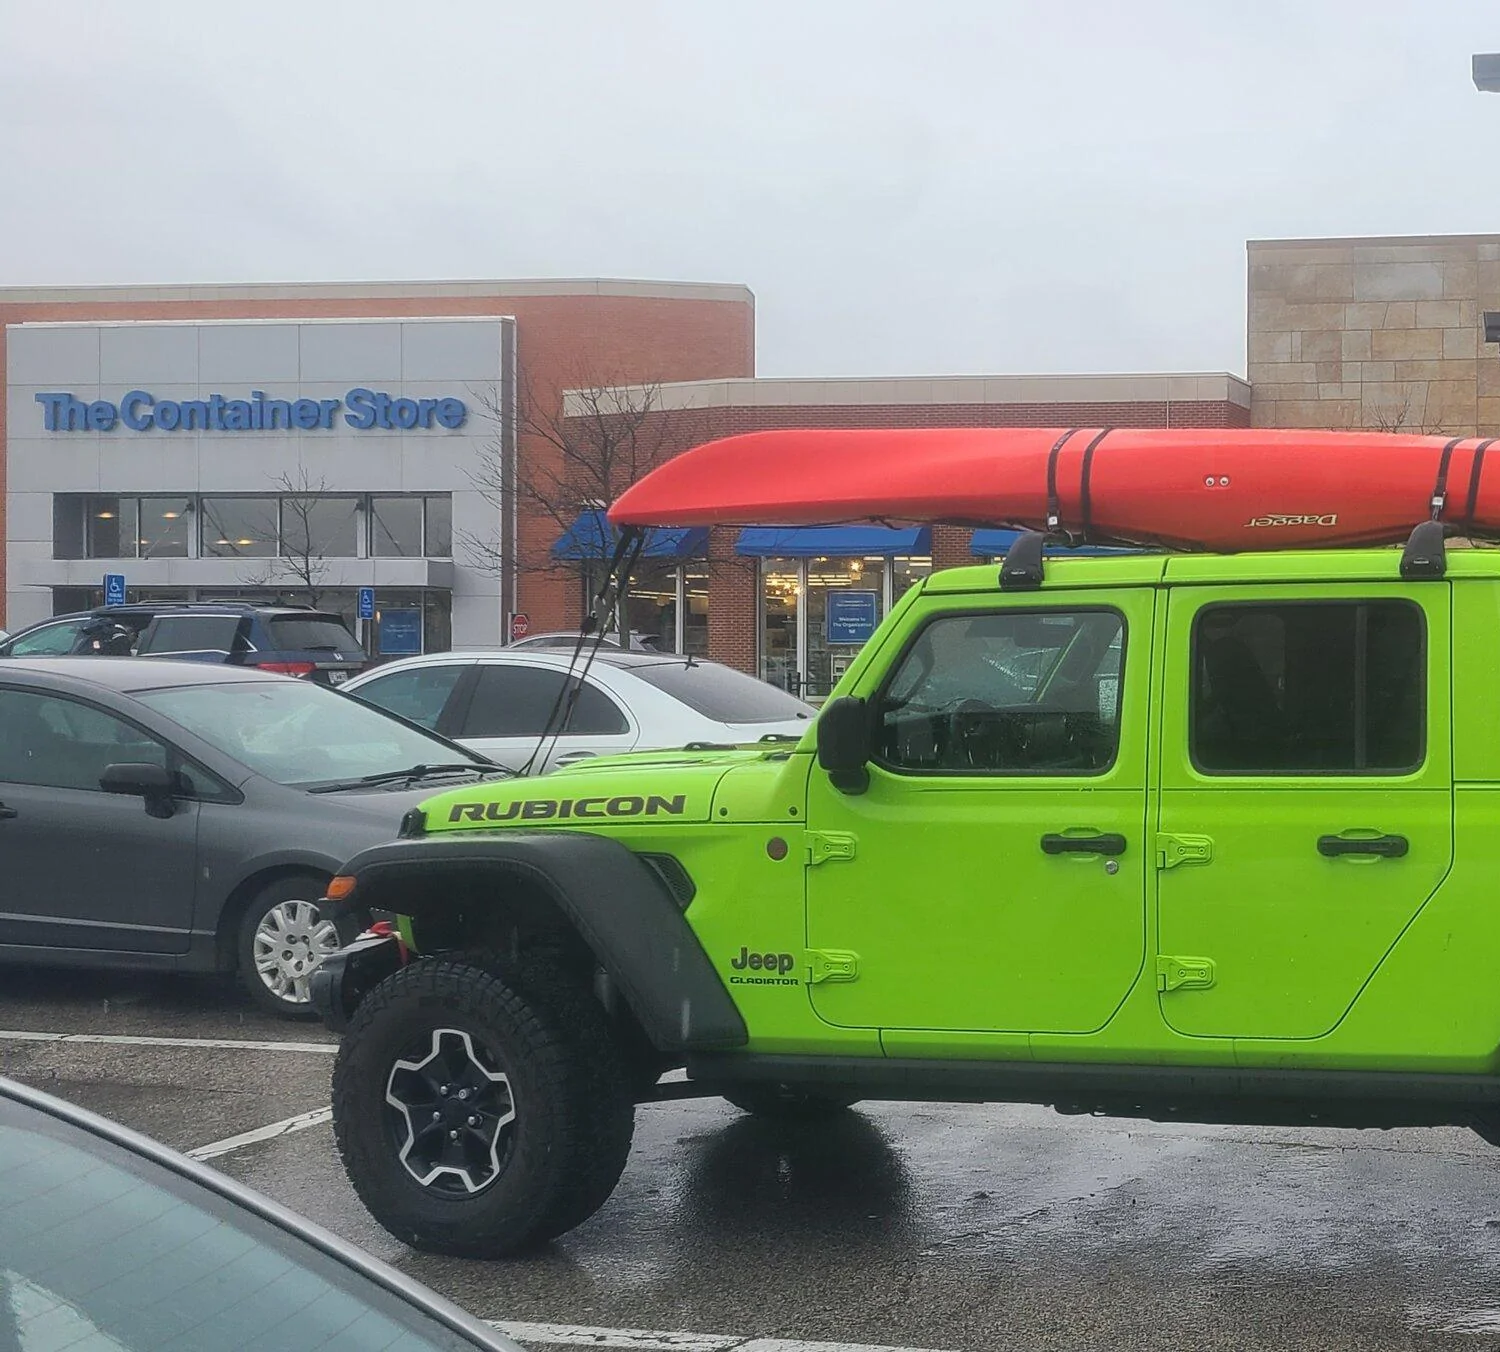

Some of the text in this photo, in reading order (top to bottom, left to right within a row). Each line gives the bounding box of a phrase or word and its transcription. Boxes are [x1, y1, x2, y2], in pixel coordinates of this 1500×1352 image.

[35, 387, 468, 432] The Container Store
[1243, 514, 1338, 528] Dagger
[513, 623, 528, 634] STOP
[448, 794, 687, 823] RUBICON
[731, 947, 794, 975] Jeep
[730, 976, 799, 986] GLADIATOR
